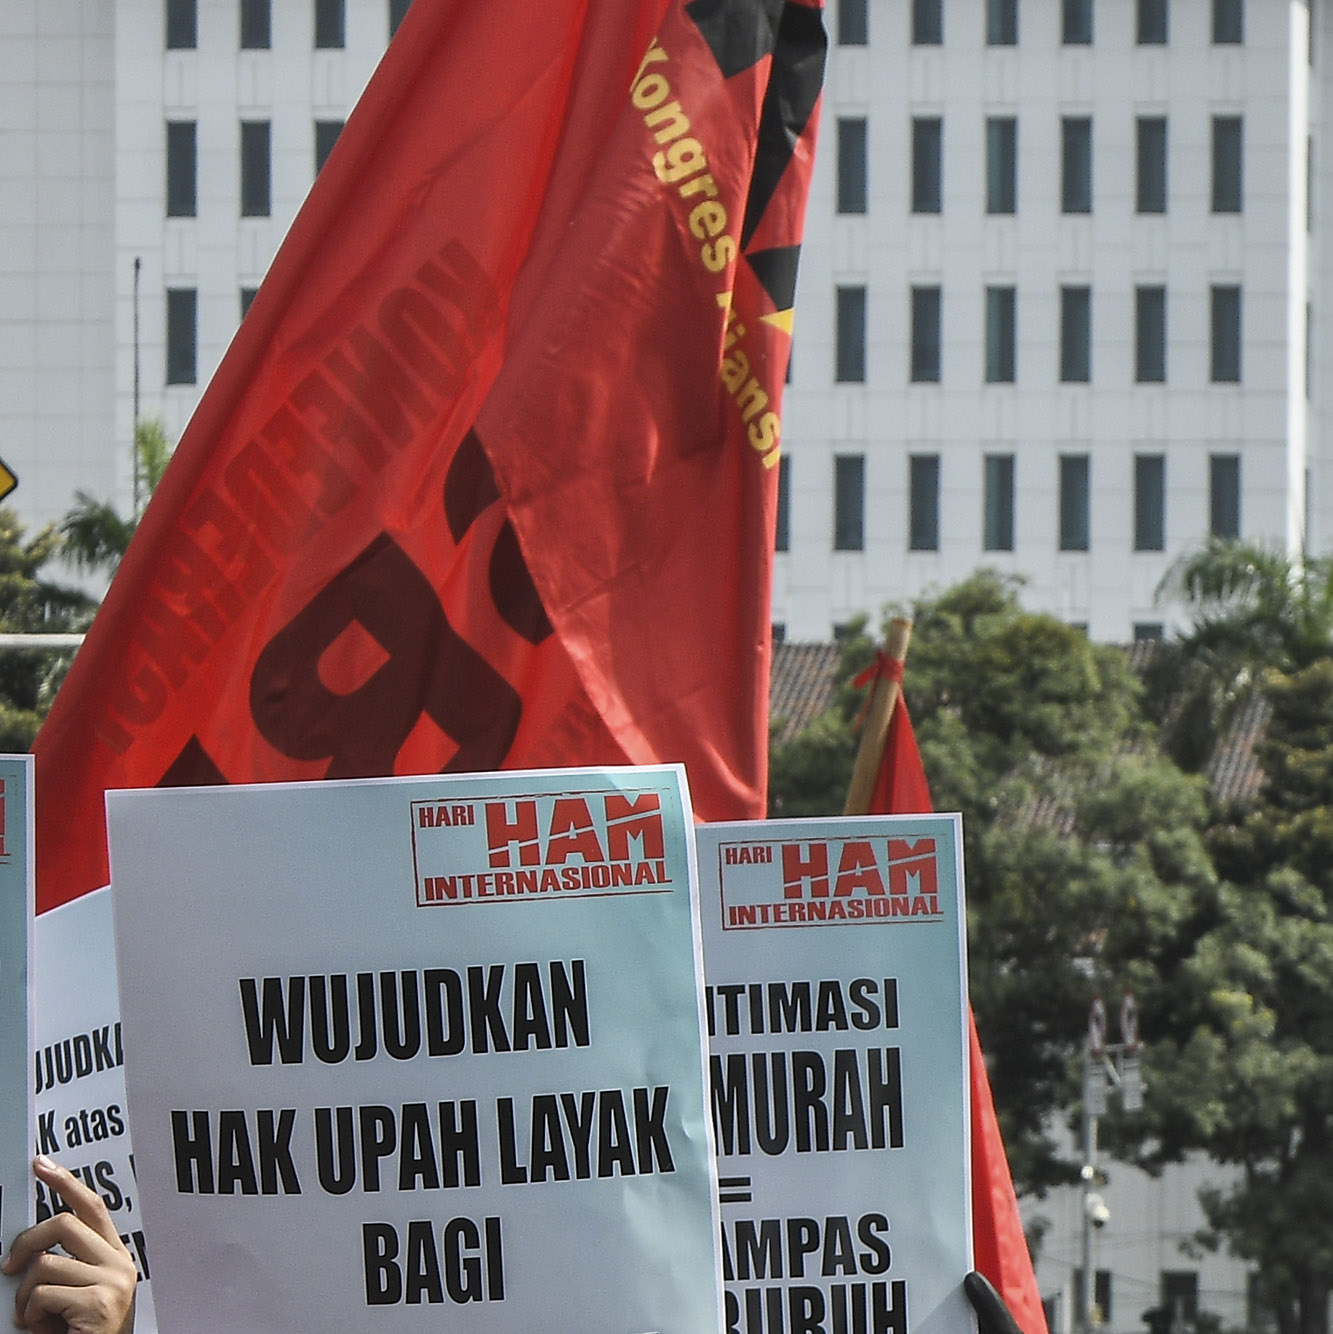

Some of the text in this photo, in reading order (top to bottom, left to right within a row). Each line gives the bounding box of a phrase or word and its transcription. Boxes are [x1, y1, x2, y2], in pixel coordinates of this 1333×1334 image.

[420, 793, 665, 868] HARI HAM
[425, 860, 669, 900] INTERNASIONAL
[726, 838, 938, 899] HARI HAM
[730, 895, 939, 925] INTERNASIONAL
[238, 959, 590, 1066] WUJUDKAN
[65, 1104, 124, 1148] atas
[709, 1046, 904, 1157] MURAH
[170, 1086, 676, 1196] HAK UPAH LAYAK
[362, 1216, 505, 1306] BAGI
